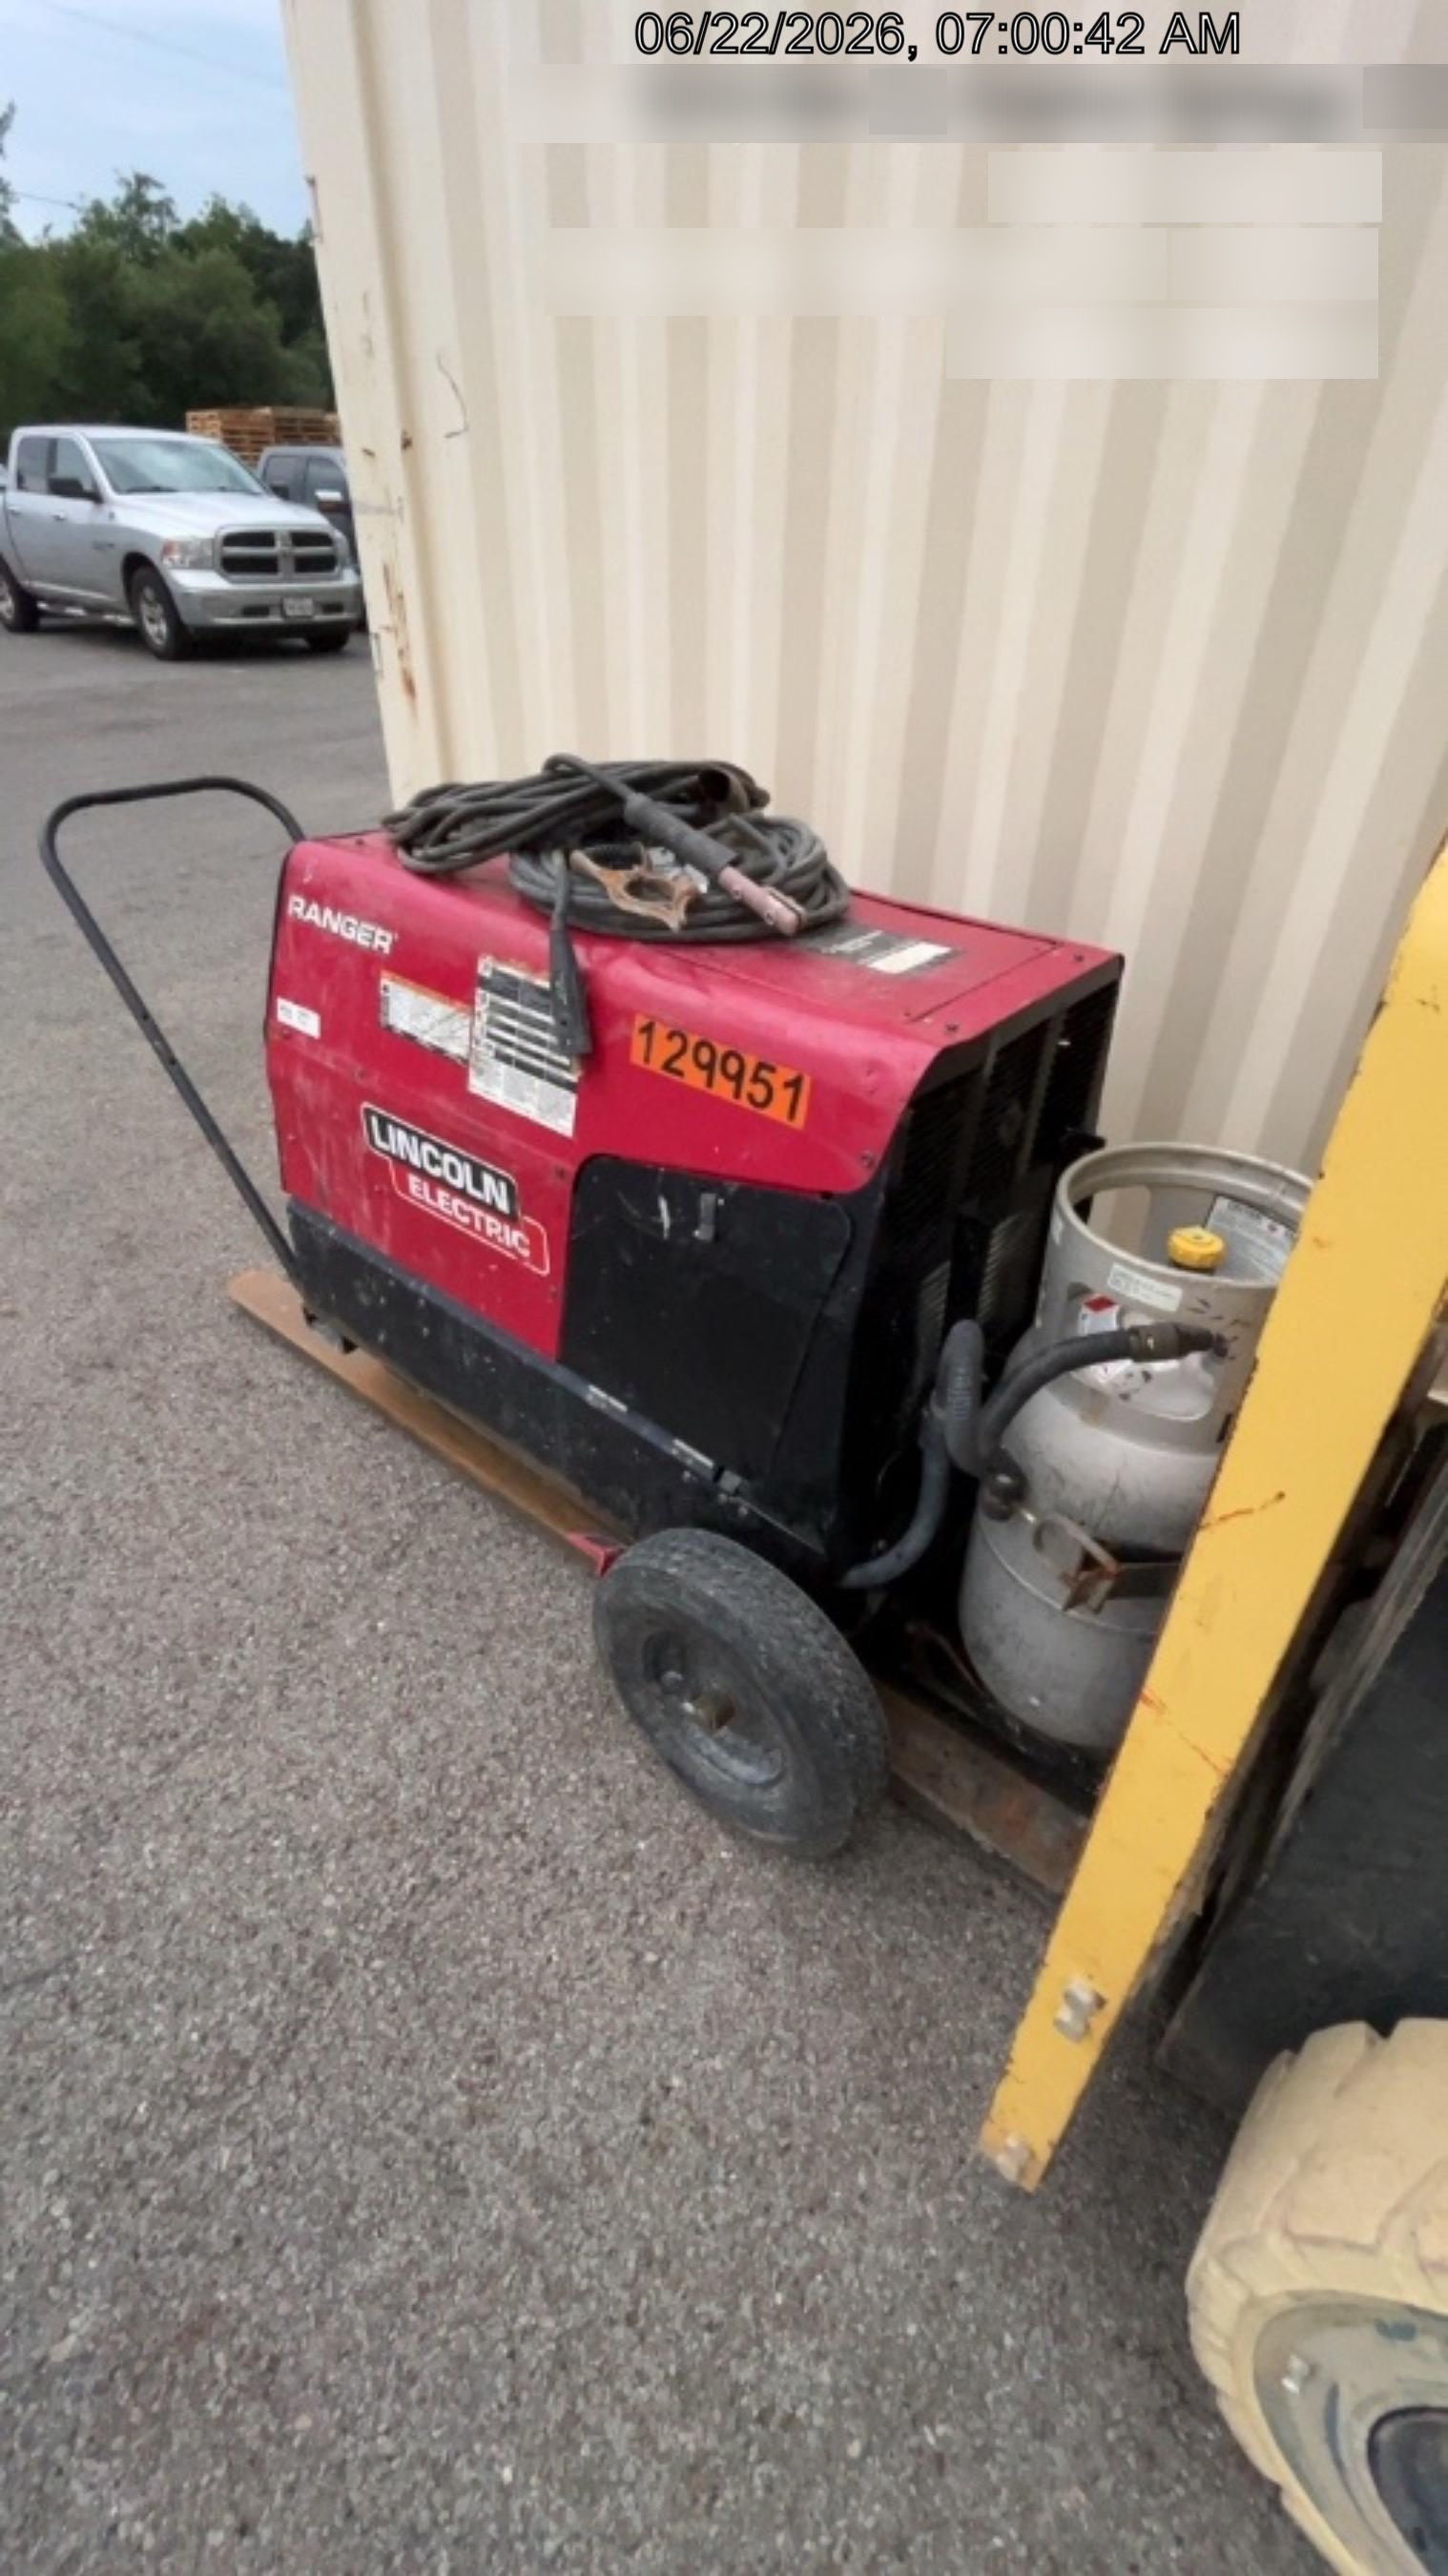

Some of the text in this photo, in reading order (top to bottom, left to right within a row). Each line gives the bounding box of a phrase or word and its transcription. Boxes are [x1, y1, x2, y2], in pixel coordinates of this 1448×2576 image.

[288, 895, 394, 955] RANGER
[637, 1020, 805, 1122] 129951
[370, 1113, 511, 1215] LINCOLN
[407, 1172, 531, 1258] ELECTRIC
